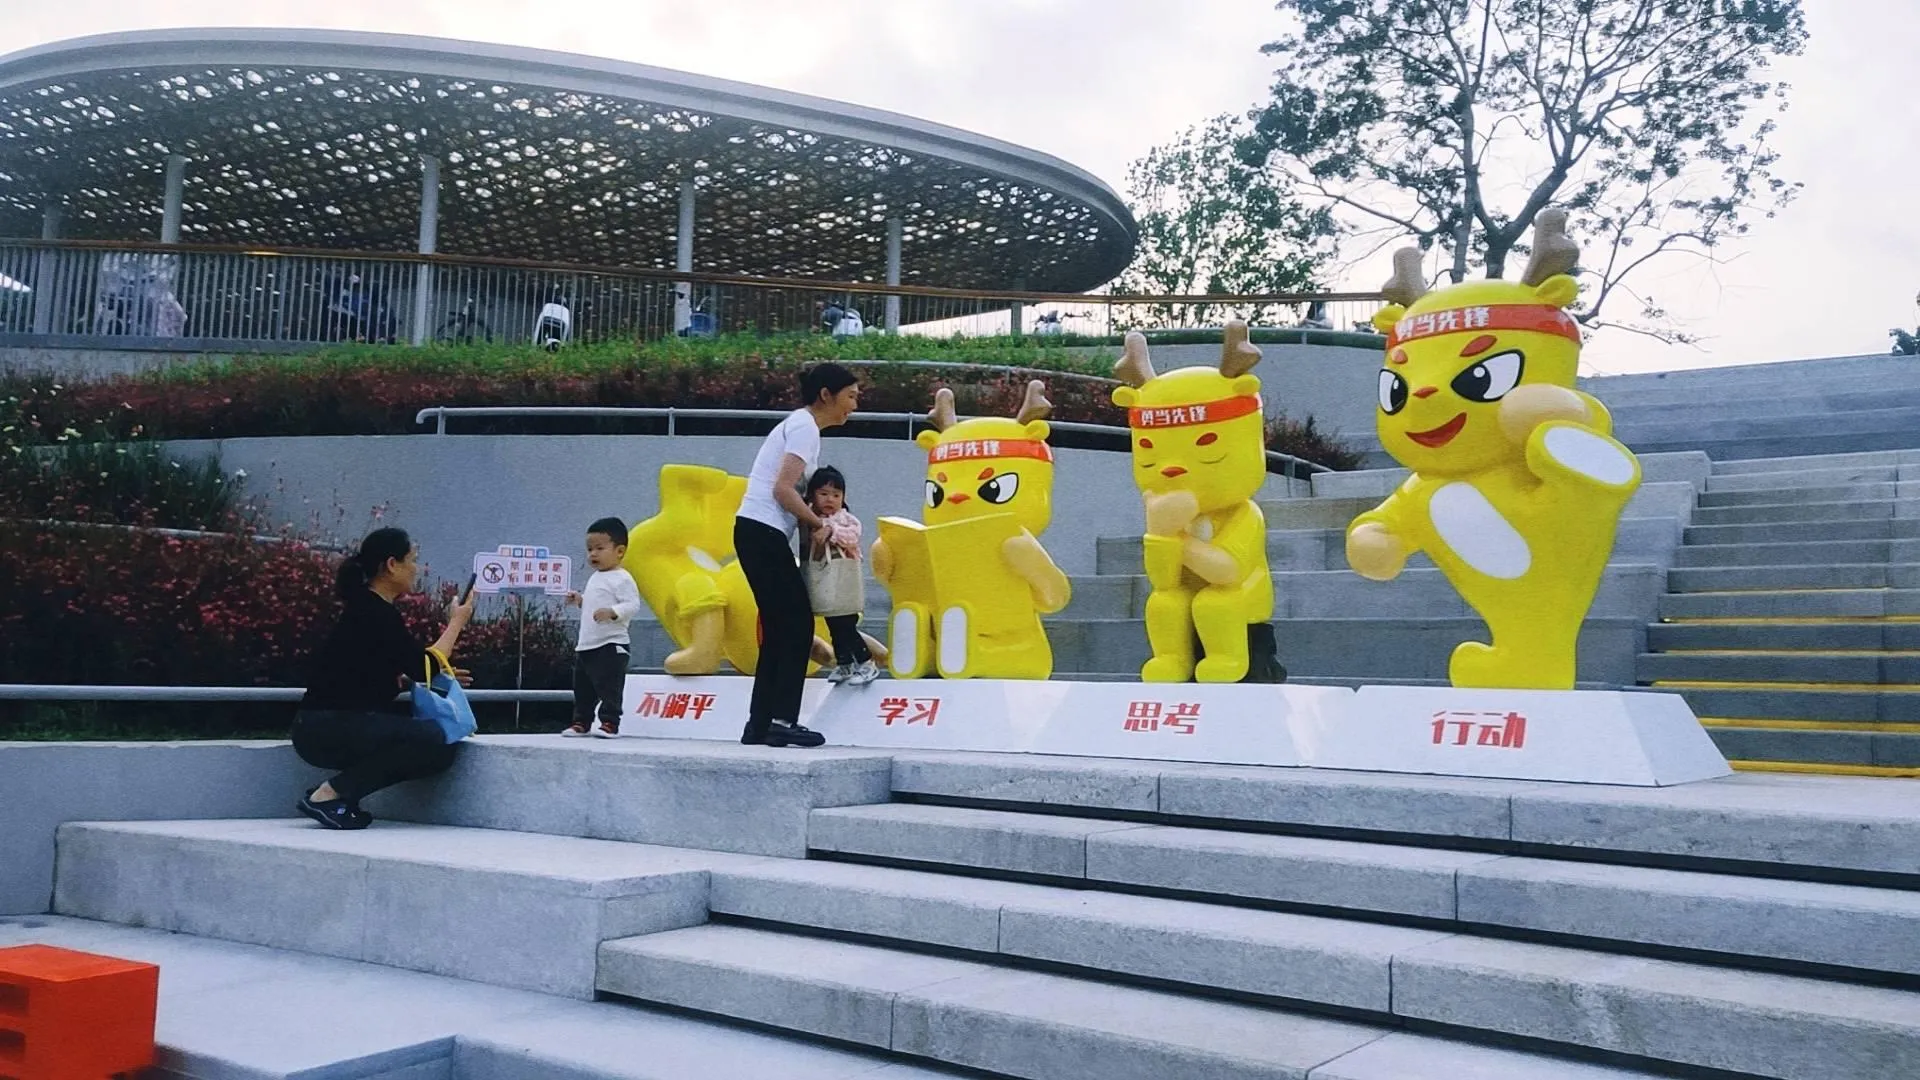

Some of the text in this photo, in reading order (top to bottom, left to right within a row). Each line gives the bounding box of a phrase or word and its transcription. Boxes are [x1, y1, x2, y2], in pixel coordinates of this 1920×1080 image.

[1141, 405, 1207, 427] 勇当先锋
[936, 441, 1000, 460] 勇当先锋
[636, 692, 718, 721] 不躺平
[877, 697, 941, 726] 学习
[1122, 701, 1202, 735] 思考
[1430, 711, 1528, 749] 行动
